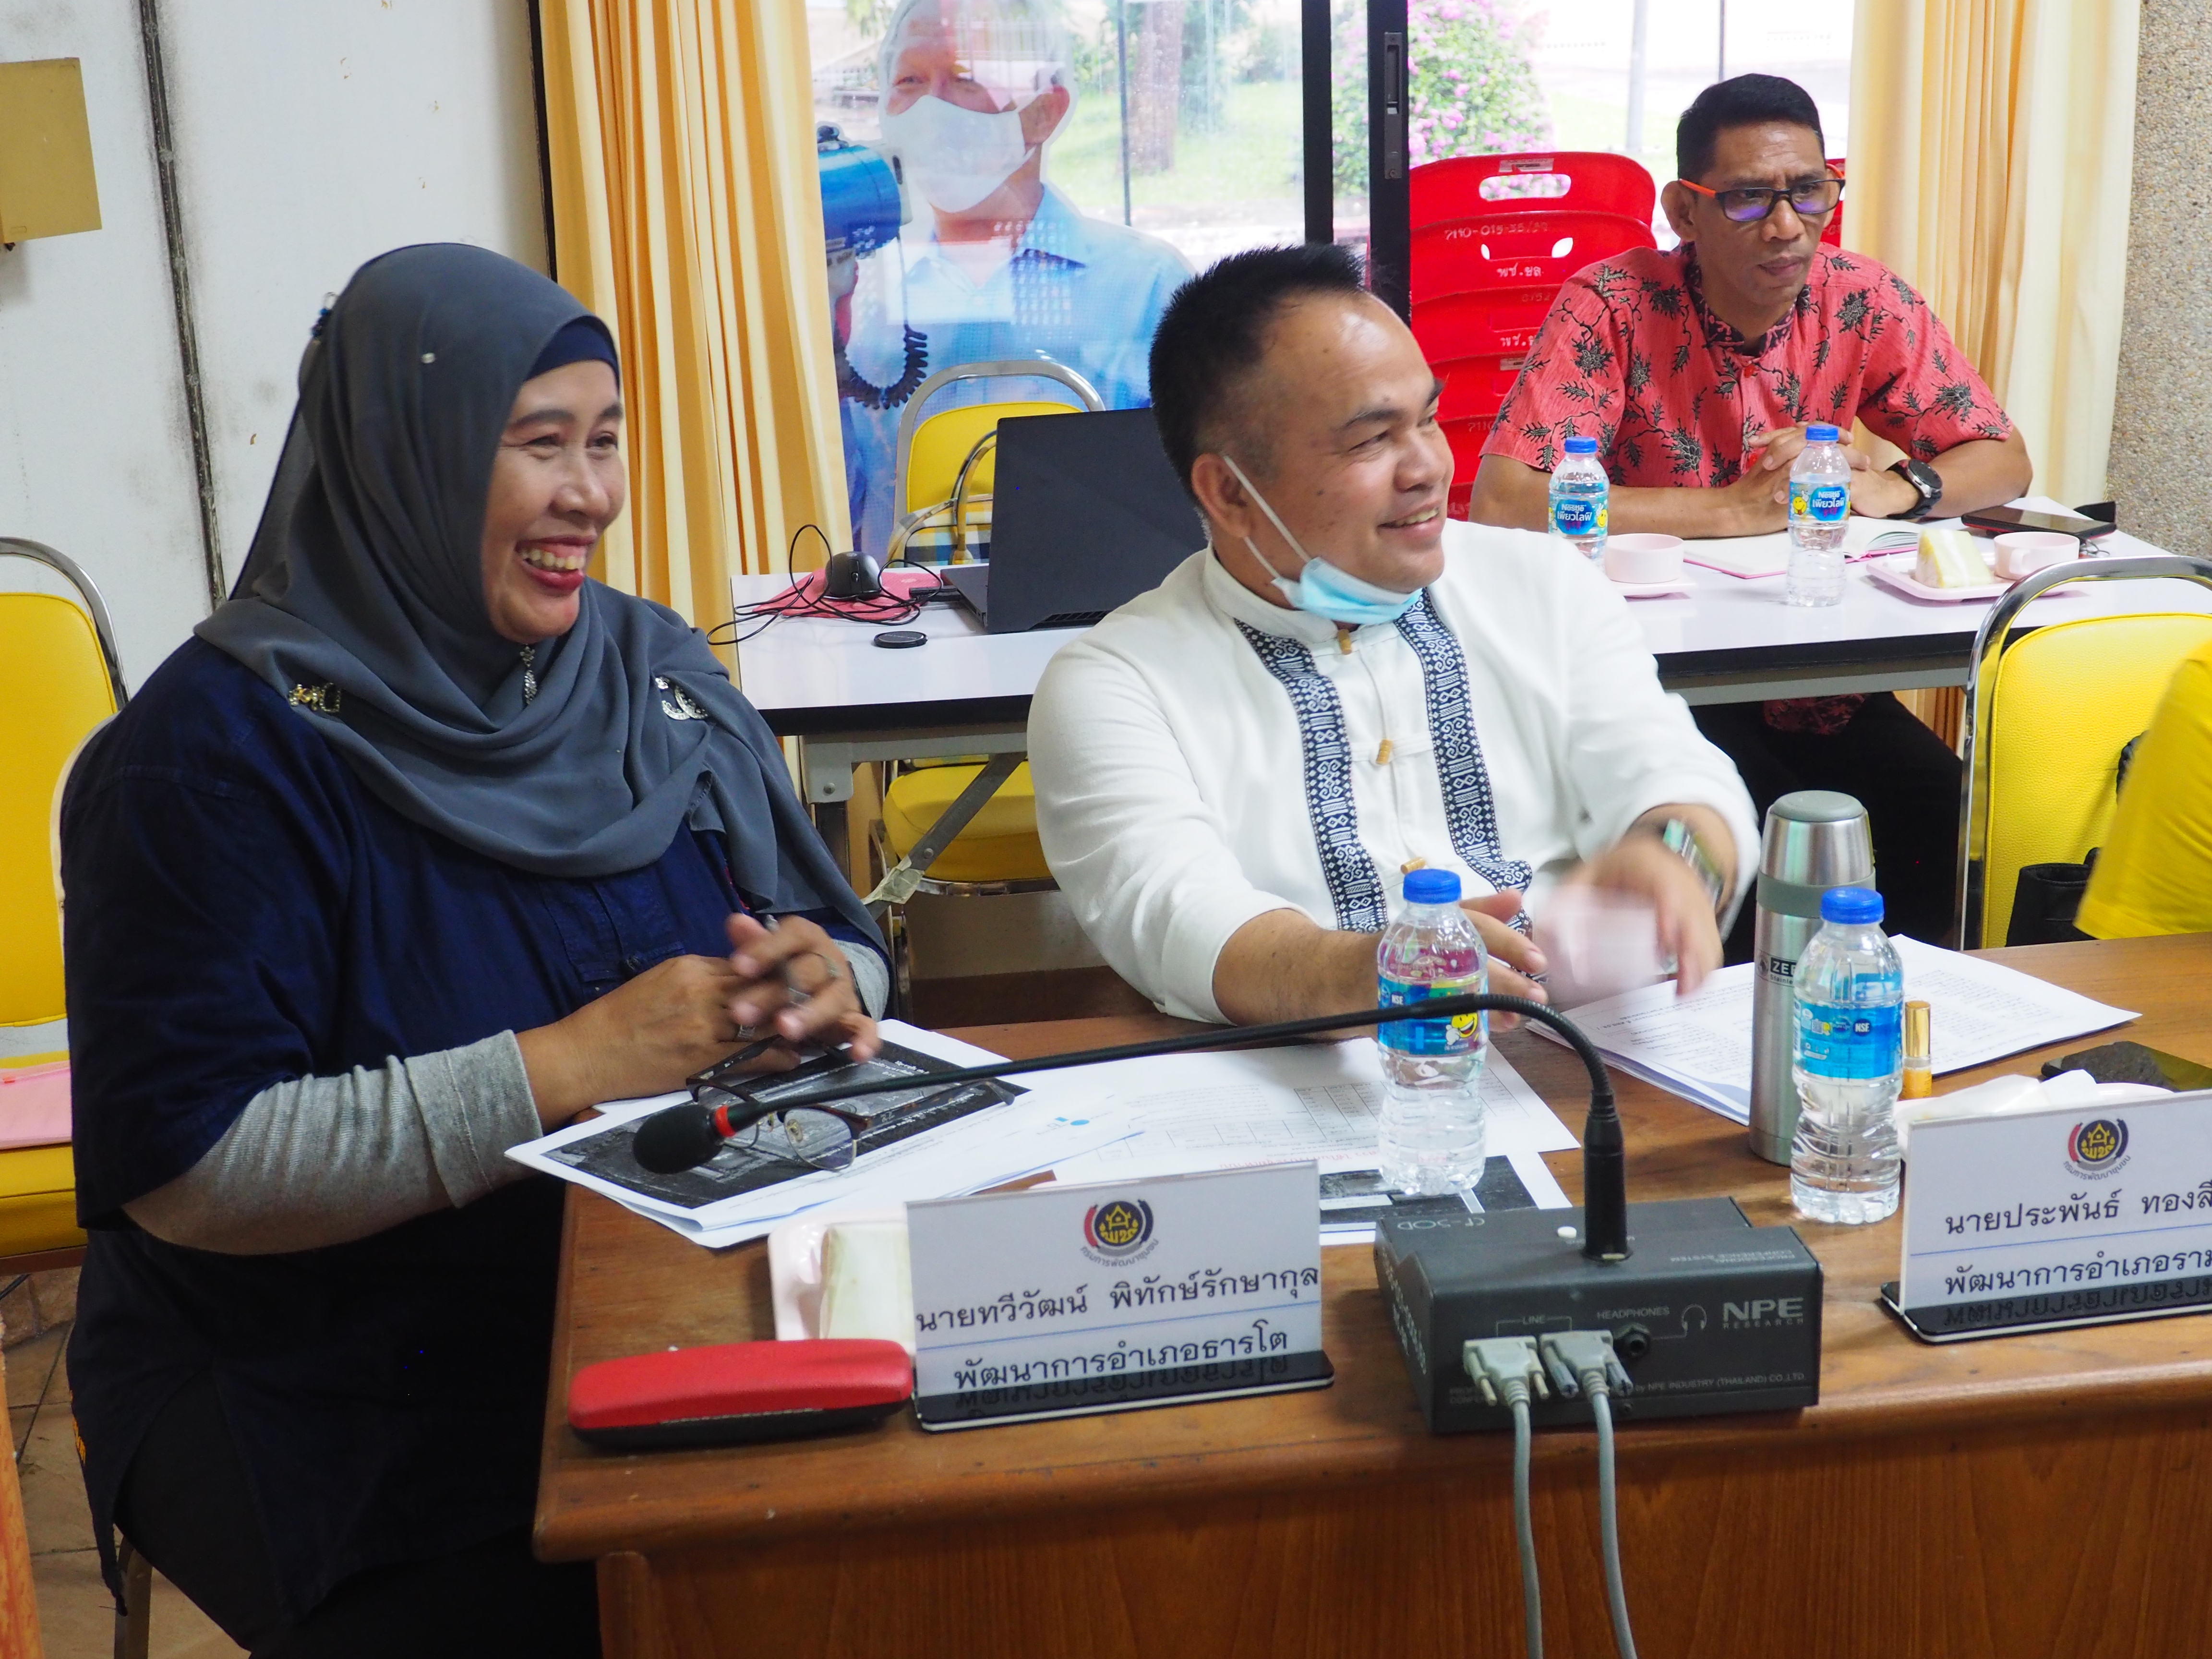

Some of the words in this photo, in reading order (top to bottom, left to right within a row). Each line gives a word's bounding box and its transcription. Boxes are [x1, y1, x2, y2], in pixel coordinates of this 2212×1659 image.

[1945, 1188, 2122, 1235] นายประพันธ์
[916, 1283, 1088, 1332] นายทวีวัฒน์
[1110, 1266, 1319, 1309] พิทักษ์รักษากุล
[1723, 1297, 1803, 1322] NPE
[1522, 1314, 1546, 1325] LINE
[1597, 1306, 1670, 1320] HEADPHONES
[954, 1319, 1288, 1390] พัฒนาการอำเภอธารโต
[1669, 1378, 1714, 1389] INDUSTRY
